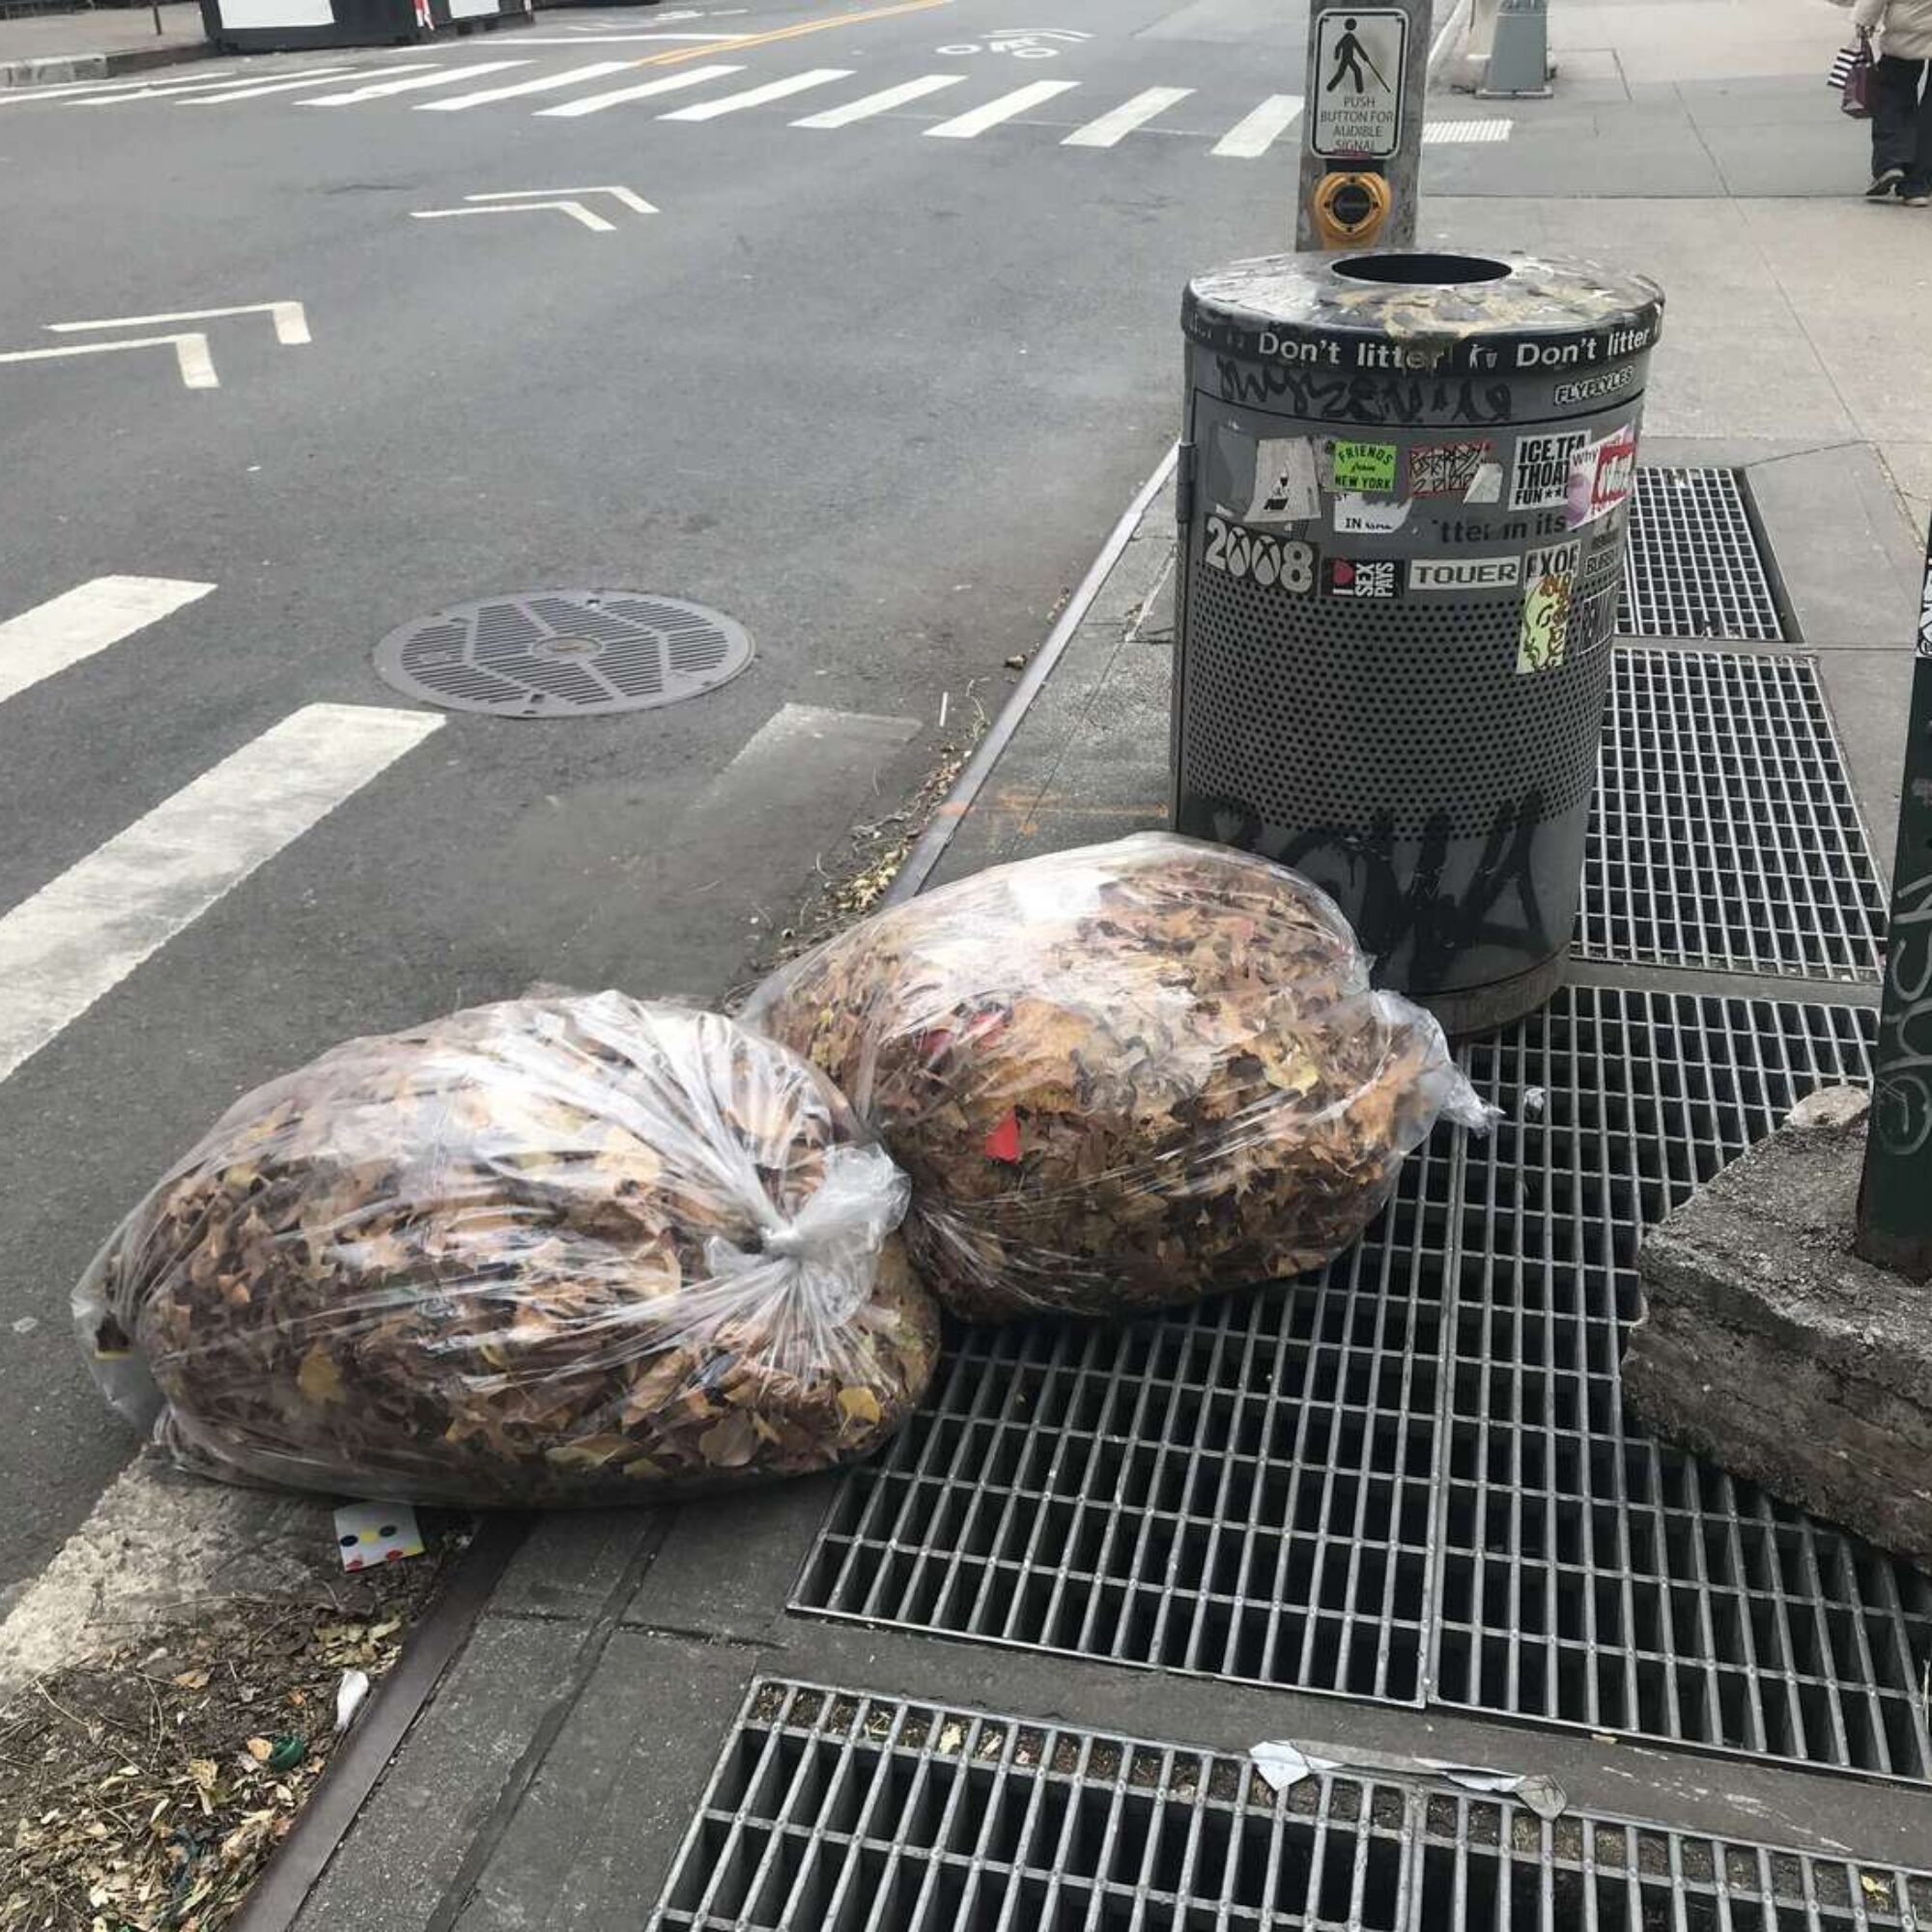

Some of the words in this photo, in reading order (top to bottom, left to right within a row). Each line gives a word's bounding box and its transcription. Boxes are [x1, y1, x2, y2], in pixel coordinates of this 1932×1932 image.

[1344, 97, 1376, 107] PUSH
[1321, 110, 1367, 123] BUTTON
[1370, 110, 1393, 123] FOR
[1333, 126, 1383, 137] AUDIBLE
[1335, 139, 1376, 151] SIGNAL
[1259, 331, 1341, 365] Don't
[1357, 341, 1445, 370] litter
[1516, 338, 1598, 367] Don't
[1606, 327, 1652, 356] litter
[1338, 443, 1394, 466] FRIENDS
[1335, 474, 1361, 488] NEW
[1362, 476, 1392, 490] YORK
[1345, 517, 1363, 529] IN
[1354, 562, 1376, 597] SEX
[1375, 561, 1395, 598] PAYS
[1413, 563, 1517, 584] TOUER
